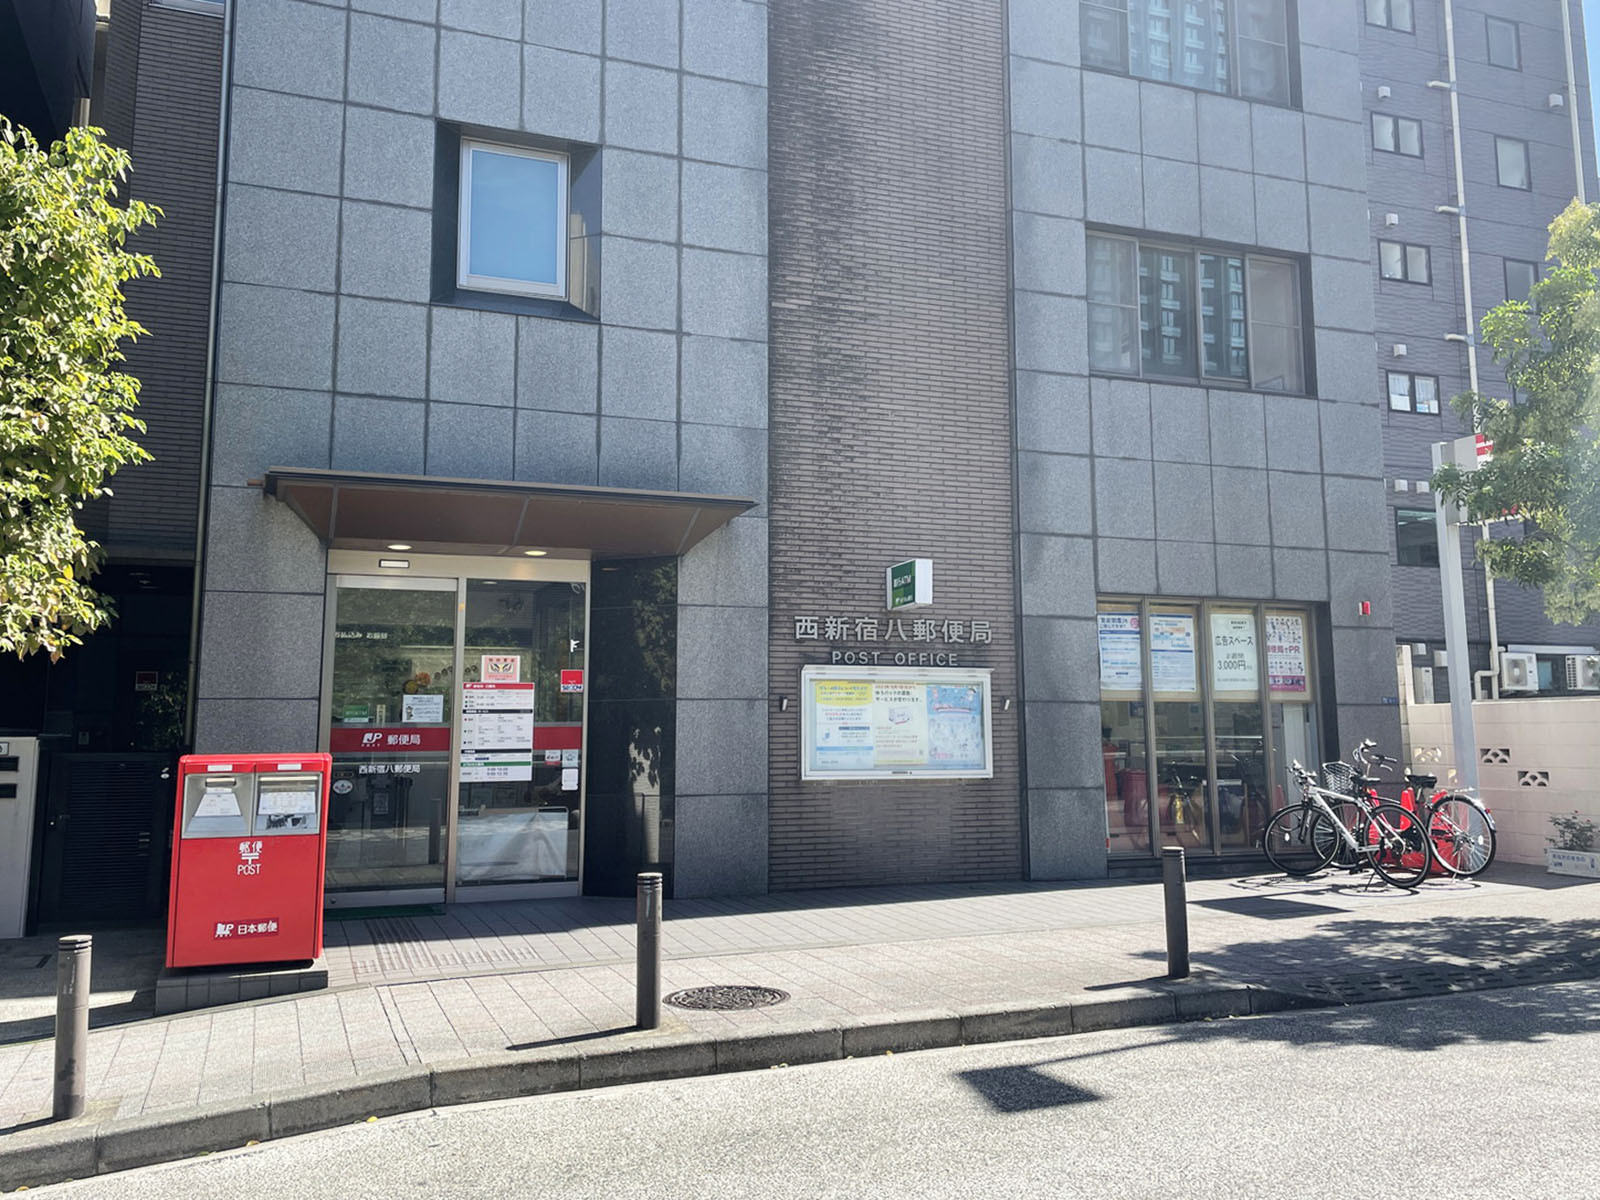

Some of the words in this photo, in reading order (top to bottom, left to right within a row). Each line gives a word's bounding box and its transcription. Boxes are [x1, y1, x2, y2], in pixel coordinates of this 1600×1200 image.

[794, 615, 993, 644] 西新宿八郵便局
[1215, 635, 1254, 647] 広告スペース
[832, 651, 881, 665] POST
[895, 652, 959, 666] OFFICE
[387, 734, 421, 746] 郵便局
[358, 764, 421, 775] 西新宿八郵便局
[238, 840, 263, 854] 郵便
[237, 864, 261, 876] POST
[237, 920, 278, 935] 日本郵便
